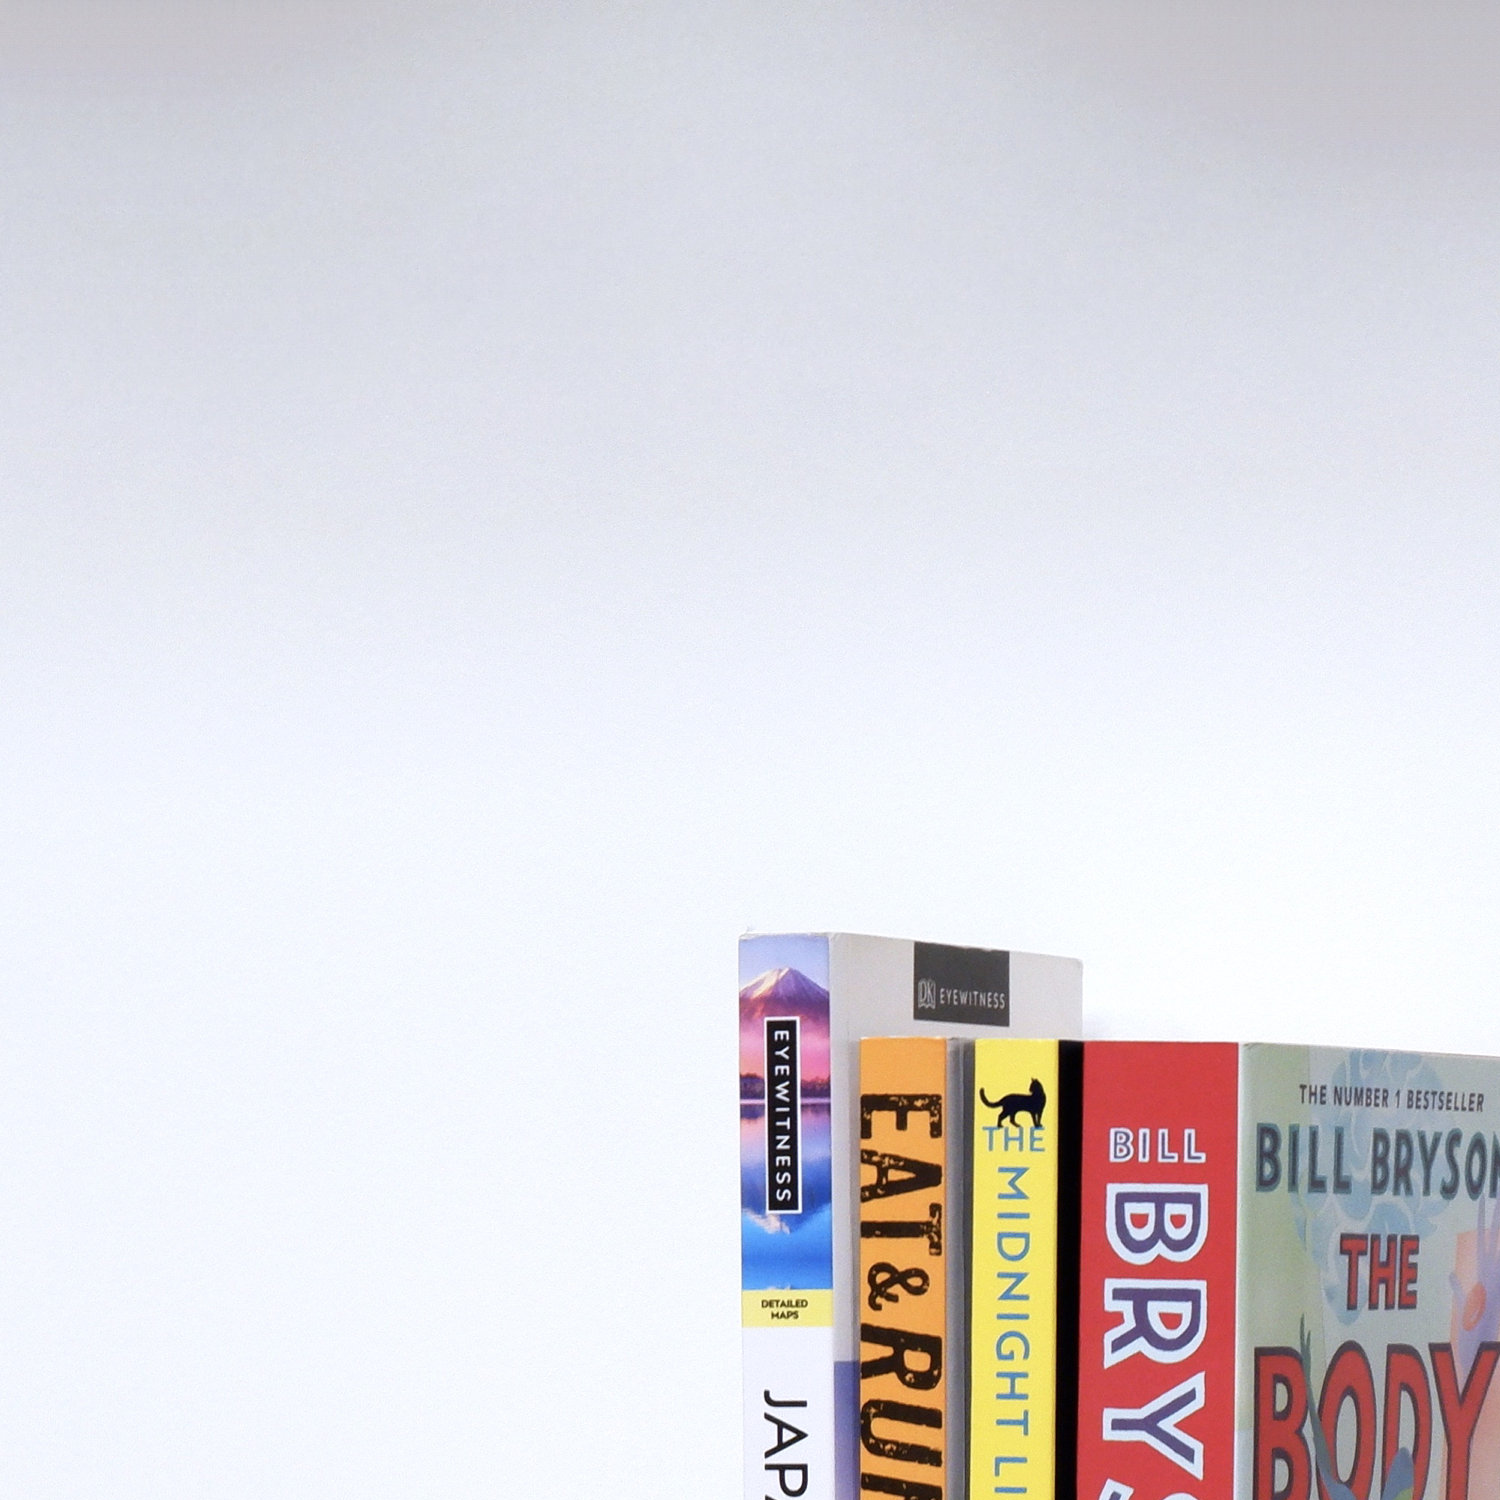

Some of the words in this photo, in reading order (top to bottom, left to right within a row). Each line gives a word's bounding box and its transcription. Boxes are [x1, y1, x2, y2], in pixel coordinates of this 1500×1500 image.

[939, 989, 1006, 1010] EYEWITNESS
[774, 1030, 792, 1202] EYEWITNESS
[1299, 1084, 1327, 1104] THE
[1333, 1086, 1389, 1109] NUMBER
[1395, 1089, 1401, 1109] 1
[1407, 1089, 1485, 1113] BESTSELLER
[982, 1126, 1046, 1152] THE
[1109, 1128, 1206, 1163] BILL
[1255, 1122, 1352, 1195] BILL
[860, 1093, 943, 1256] EAT
[868, 1262, 930, 1311] &
[1339, 1233, 1420, 1311] THE
[761, 1299, 808, 1309] DETAILED
[771, 1311, 799, 1320] MAPS
[994, 1167, 1031, 1436] MIDNIGHT
